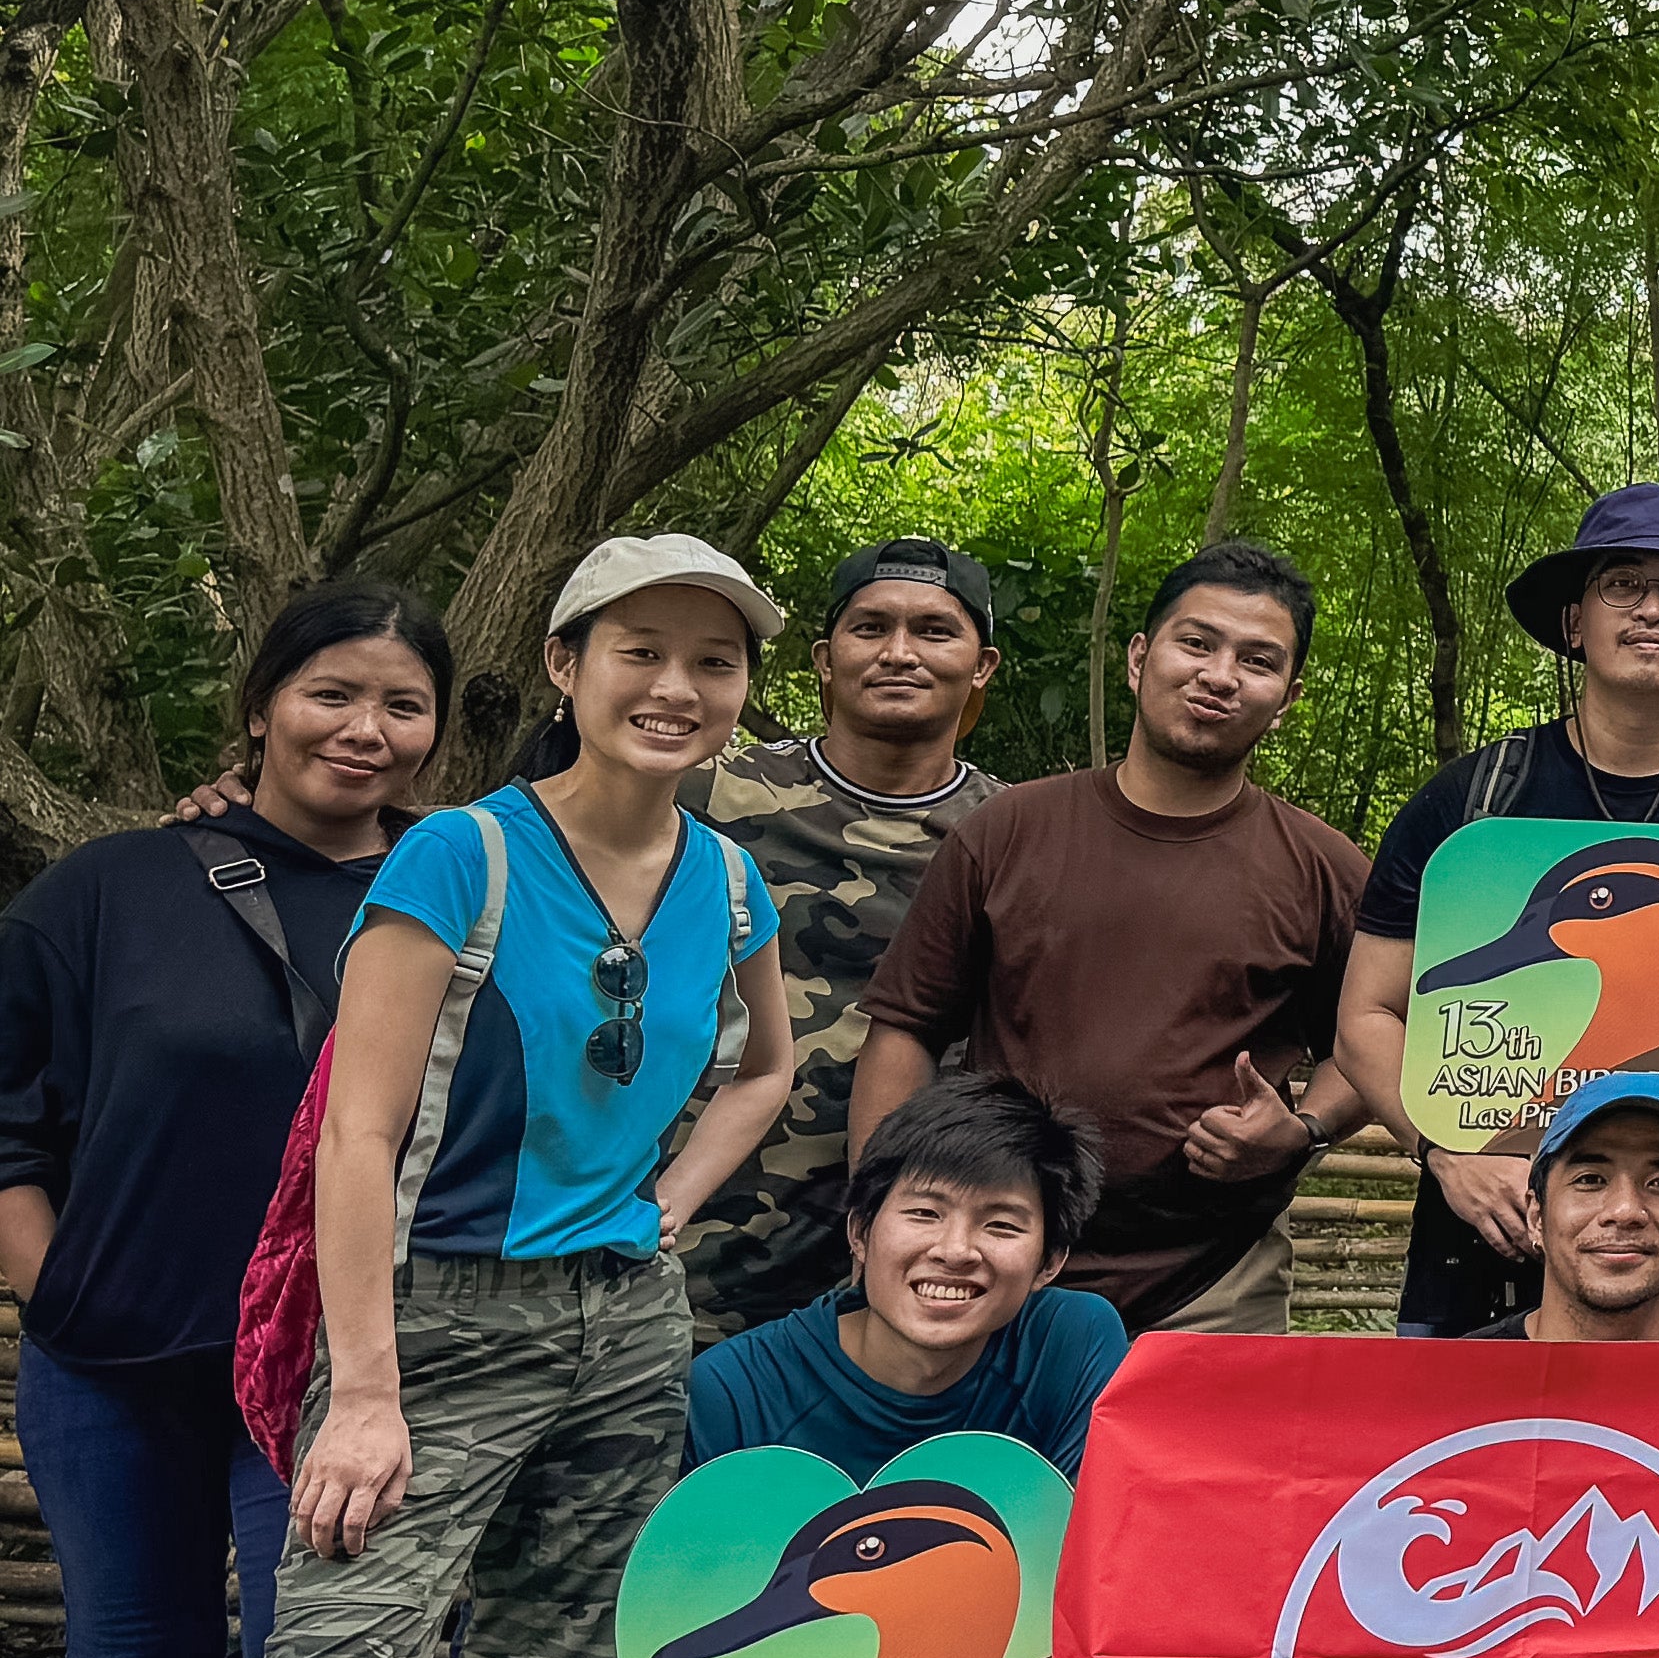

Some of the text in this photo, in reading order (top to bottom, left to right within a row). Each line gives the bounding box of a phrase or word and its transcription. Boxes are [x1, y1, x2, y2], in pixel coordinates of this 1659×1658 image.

[1439, 999, 1541, 1060] 13th
[1428, 1064, 1546, 1098] ASIAN
[1458, 1101, 1512, 1130] Las
